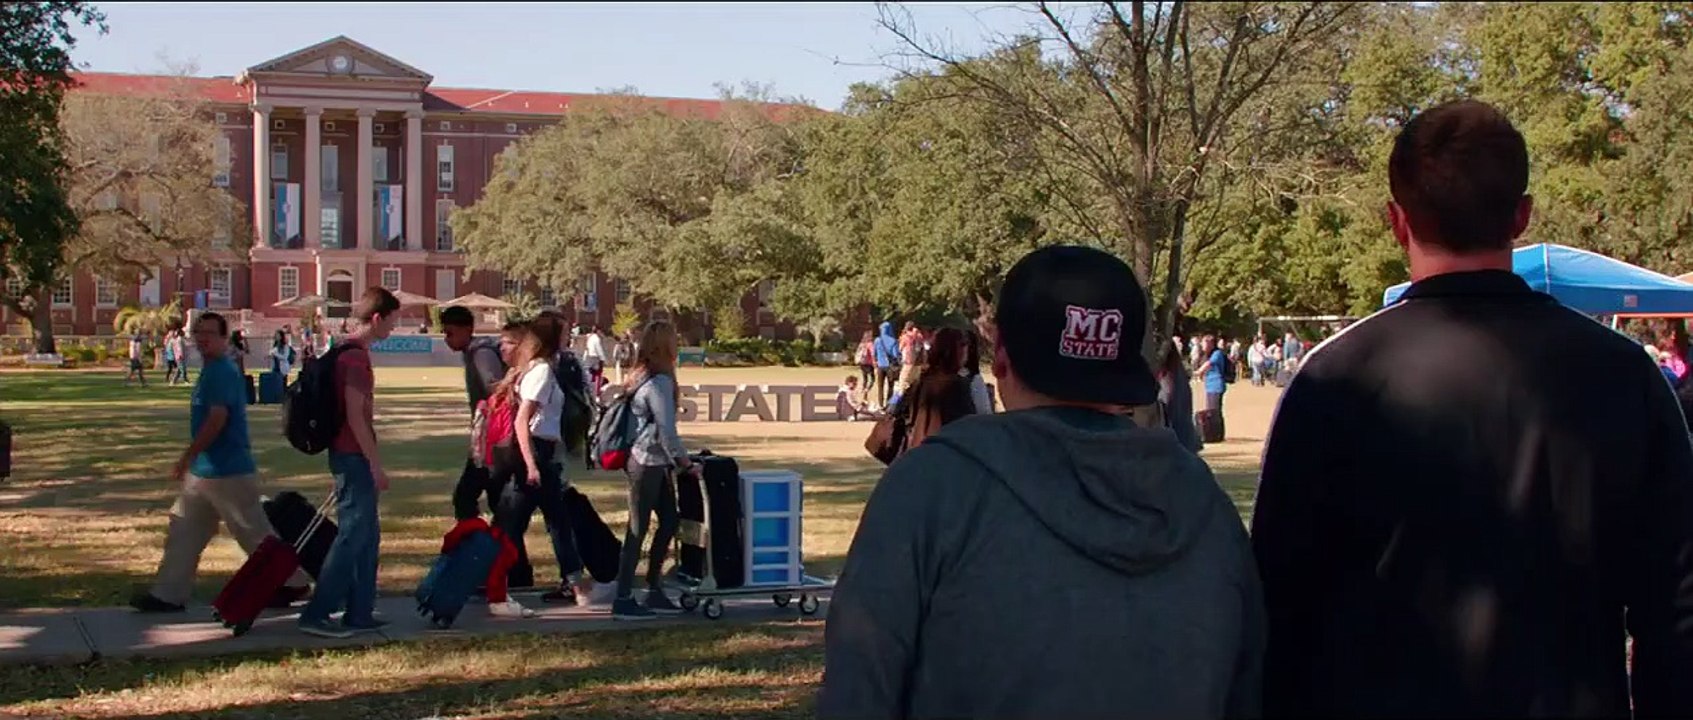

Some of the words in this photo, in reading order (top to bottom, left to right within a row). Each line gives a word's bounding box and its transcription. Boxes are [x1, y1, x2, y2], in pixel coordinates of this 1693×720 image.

[1066, 308, 1119, 342] MC
[1062, 340, 1117, 356] STATE
[677, 384, 840, 422] STATE
